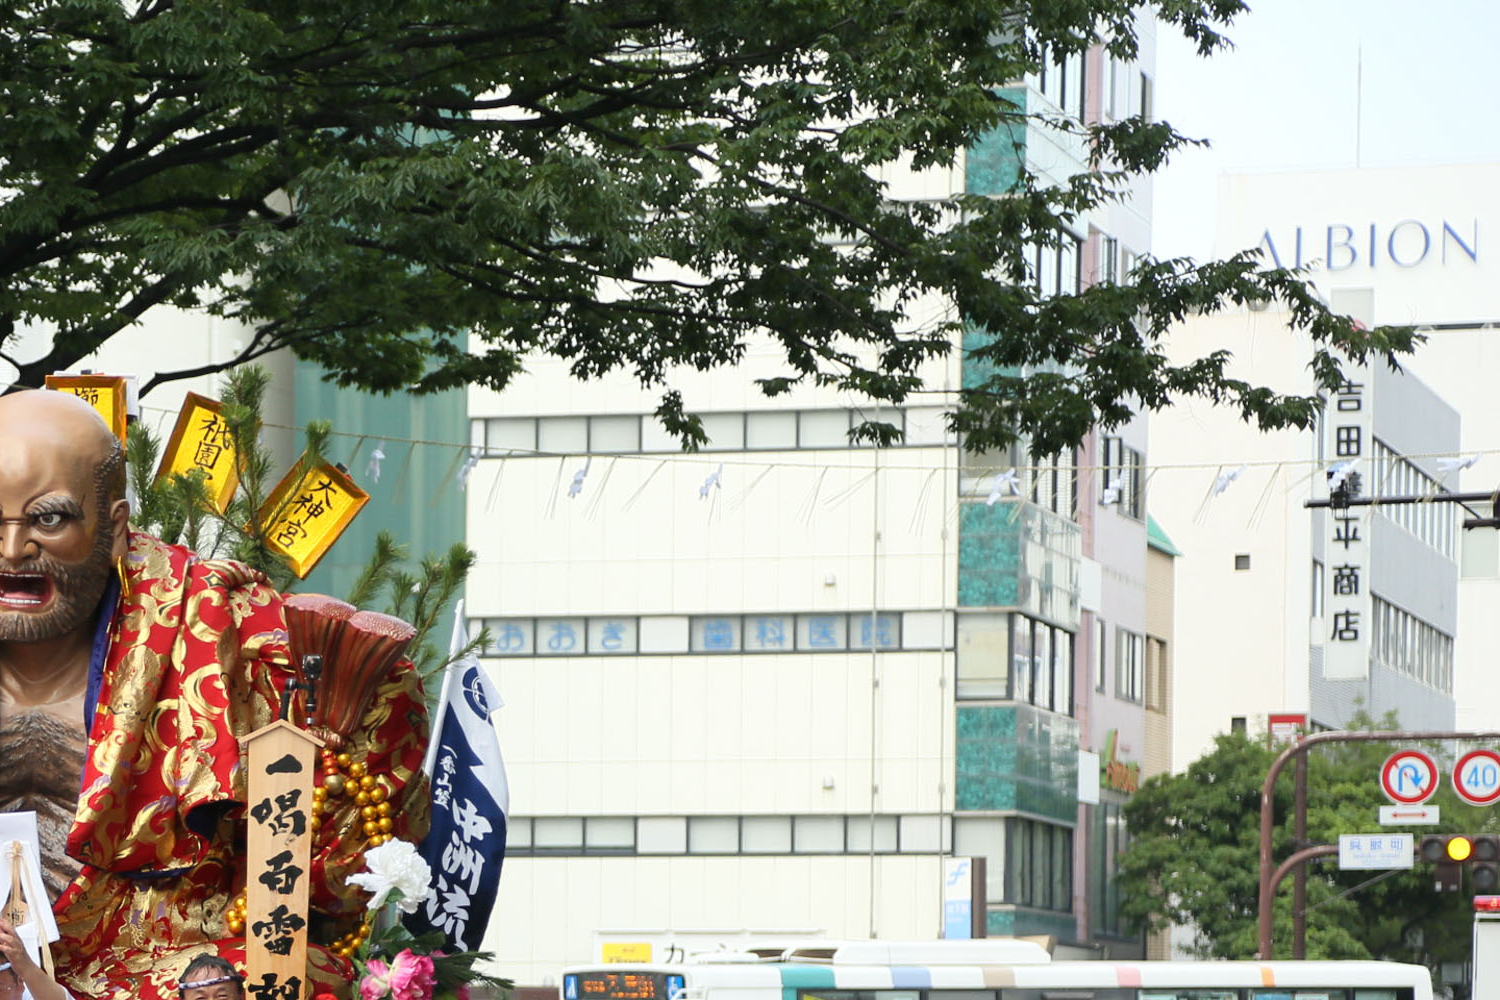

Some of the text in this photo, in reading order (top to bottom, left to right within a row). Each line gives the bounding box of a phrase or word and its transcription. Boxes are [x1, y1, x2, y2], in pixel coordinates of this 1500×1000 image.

[1258, 218, 1478, 270] ALBION
[277, 479, 338, 548] 大神宮
[1467, 763, 1497, 788] 40
